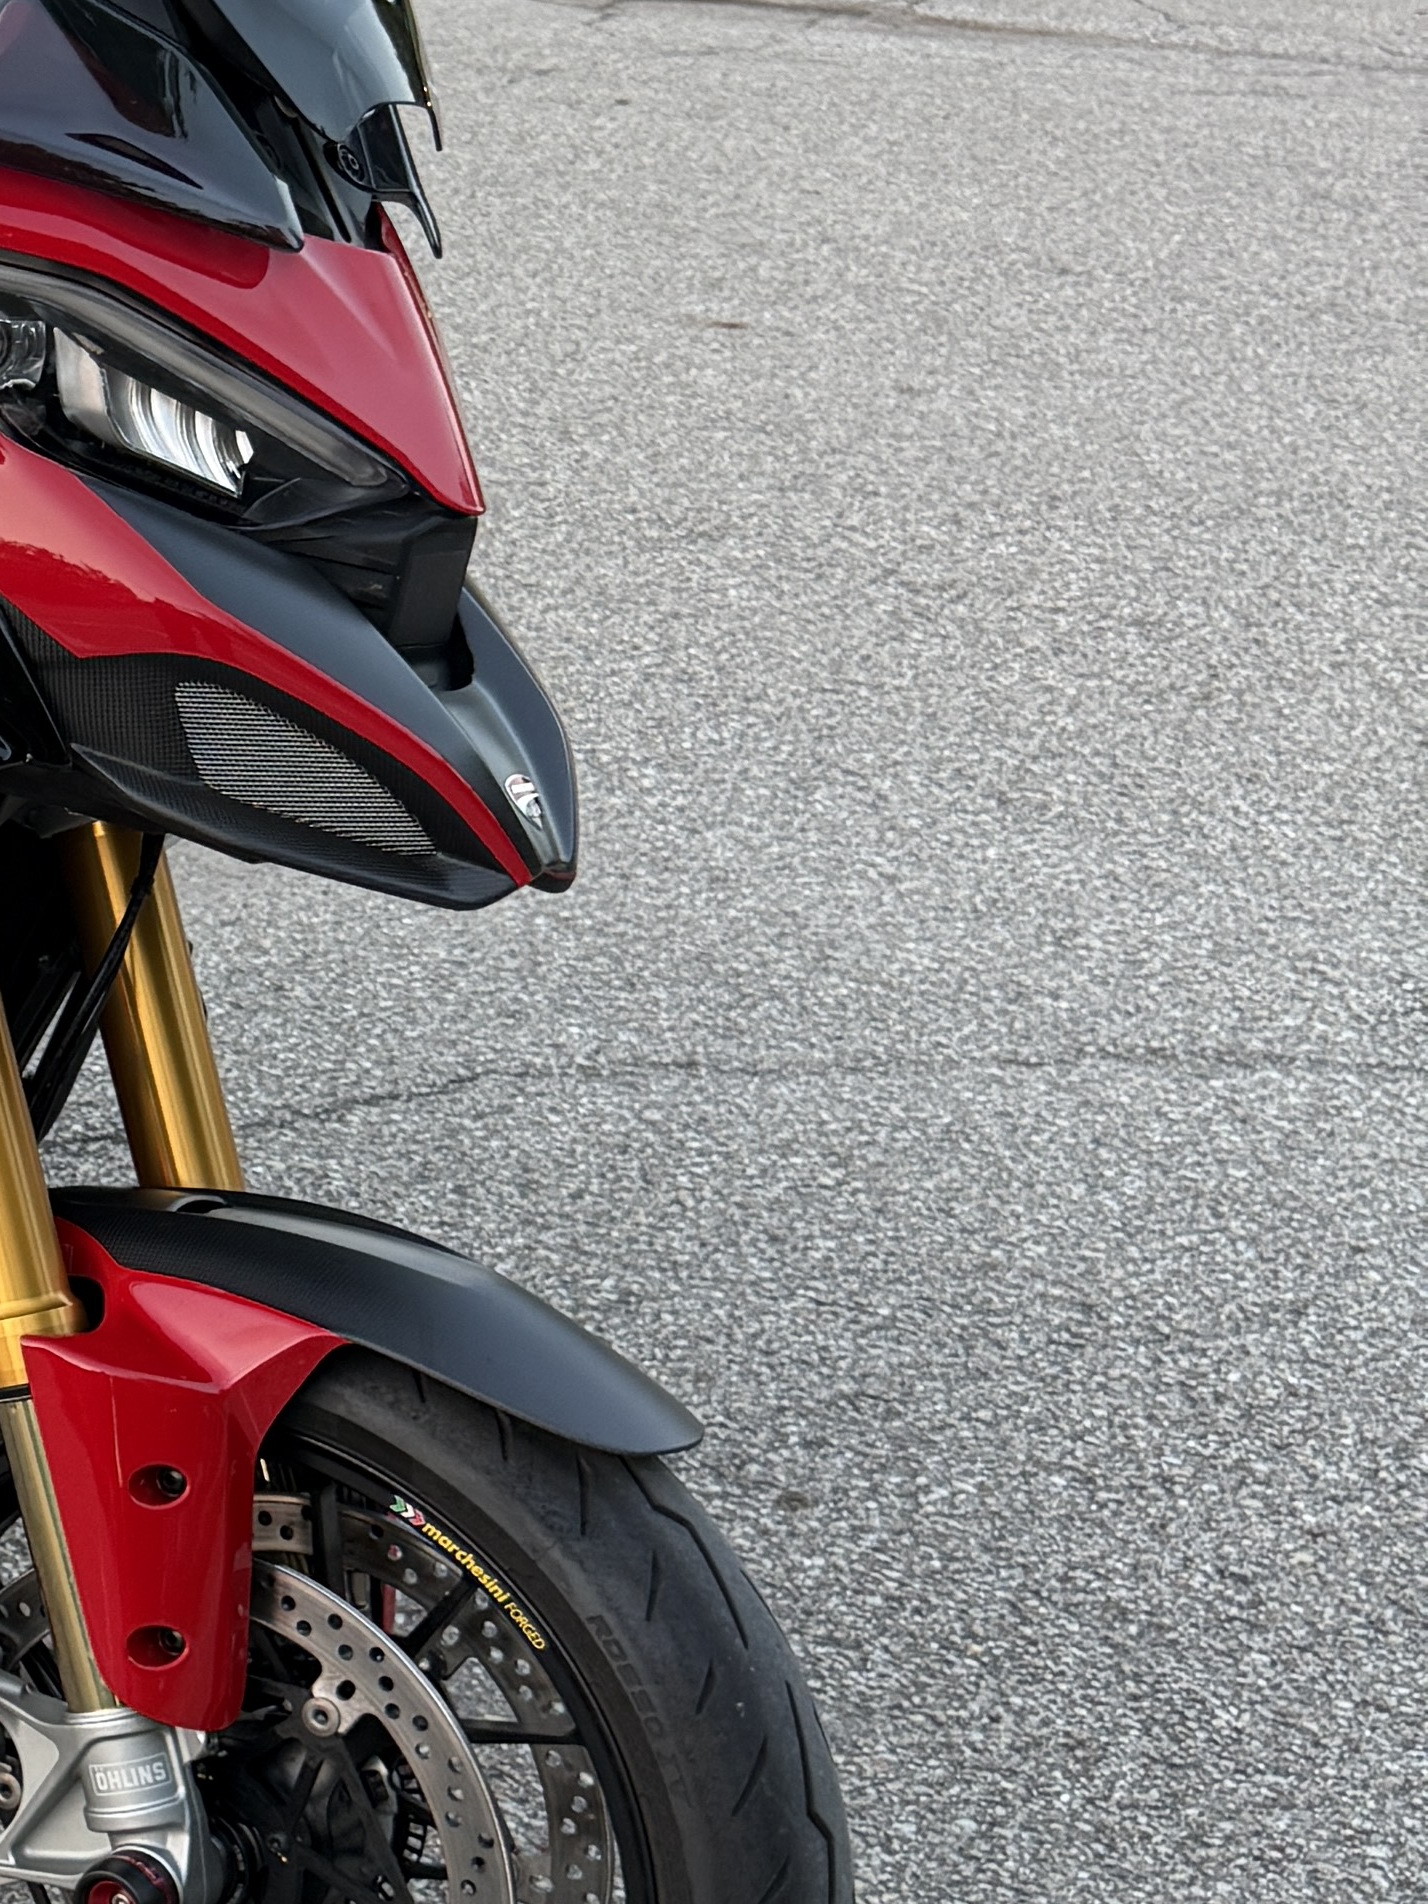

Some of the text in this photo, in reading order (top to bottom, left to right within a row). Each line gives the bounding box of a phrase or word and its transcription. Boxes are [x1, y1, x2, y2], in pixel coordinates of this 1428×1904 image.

[422, 1523, 546, 1650] marchesini FORGED
[94, 1761, 167, 1792] ÖHLINS
